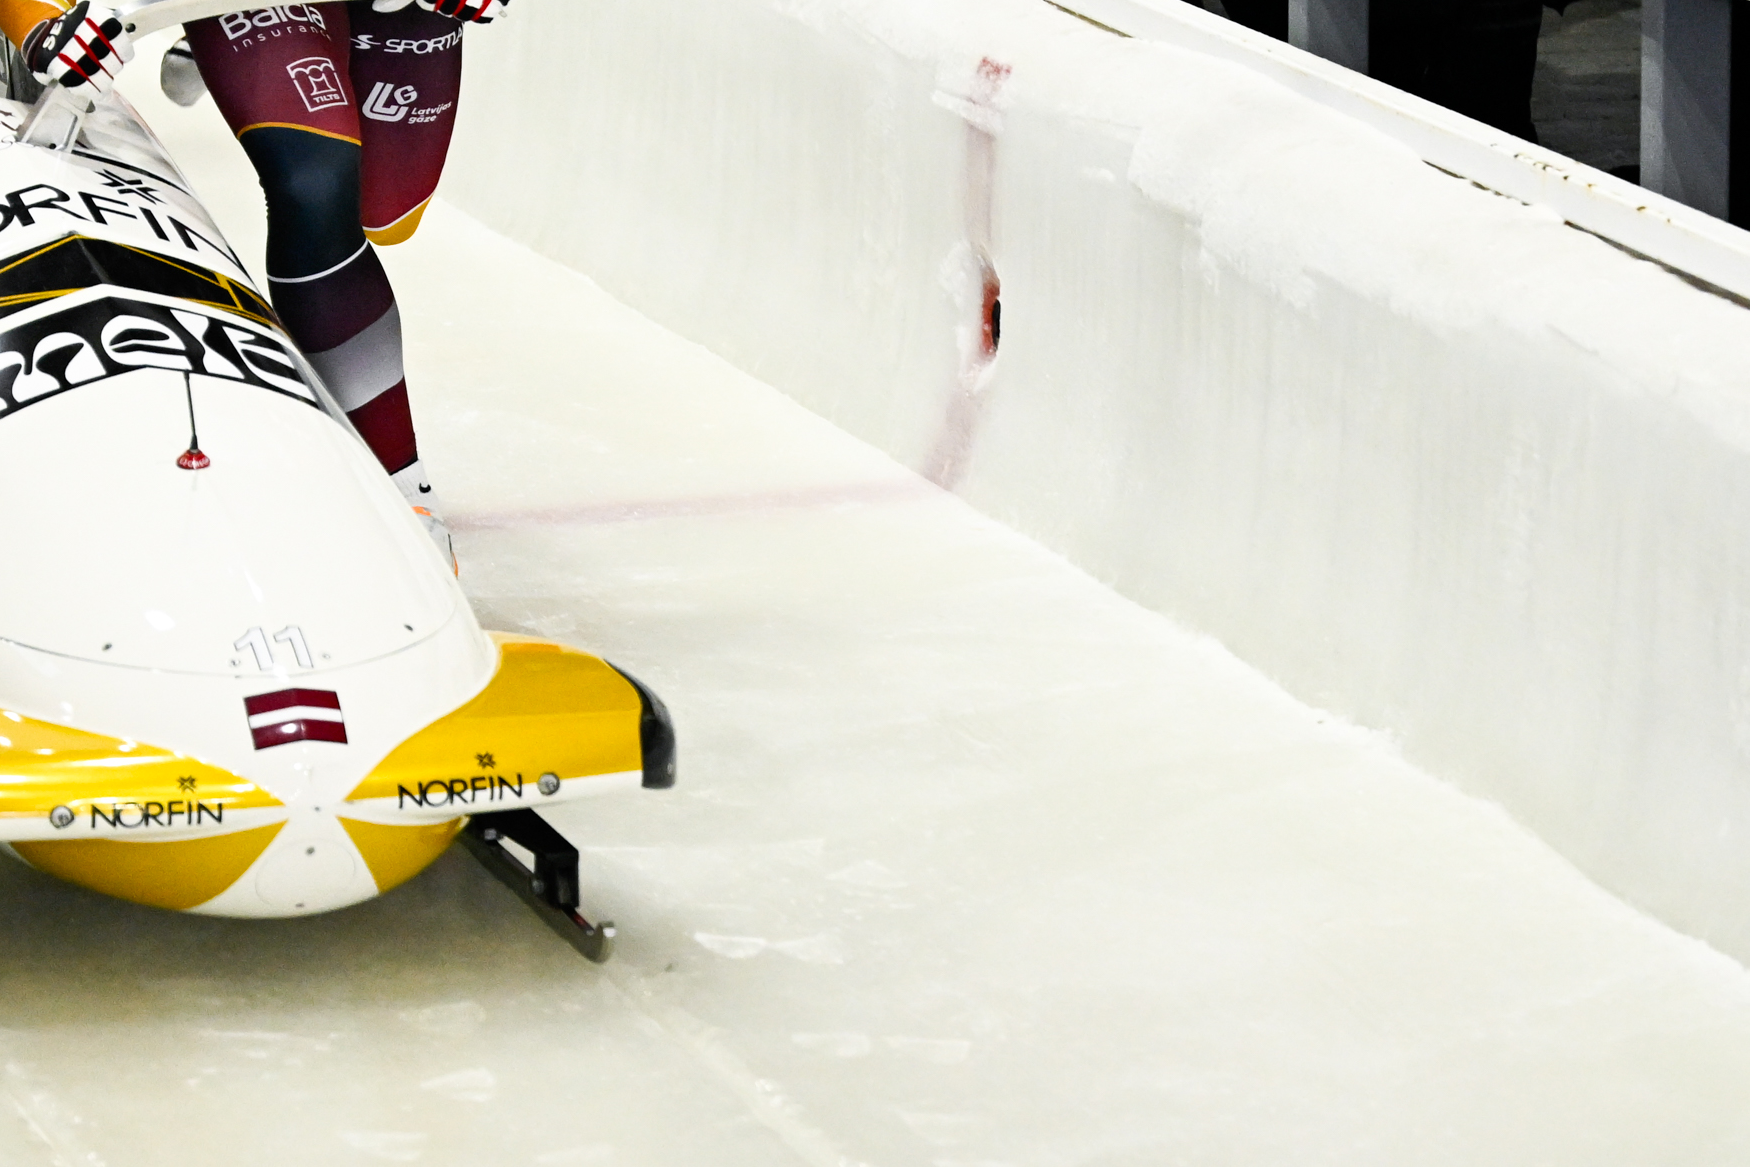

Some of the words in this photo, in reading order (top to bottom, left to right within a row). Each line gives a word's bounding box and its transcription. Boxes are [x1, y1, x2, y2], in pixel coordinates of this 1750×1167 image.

[218, 2, 328, 41] Balcia
[313, 92, 341, 104] TILTS
[410, 100, 453, 116] Latvijas
[233, 624, 315, 672] 11
[397, 772, 524, 810] NORFIN
[90, 800, 224, 830] NORFIN
